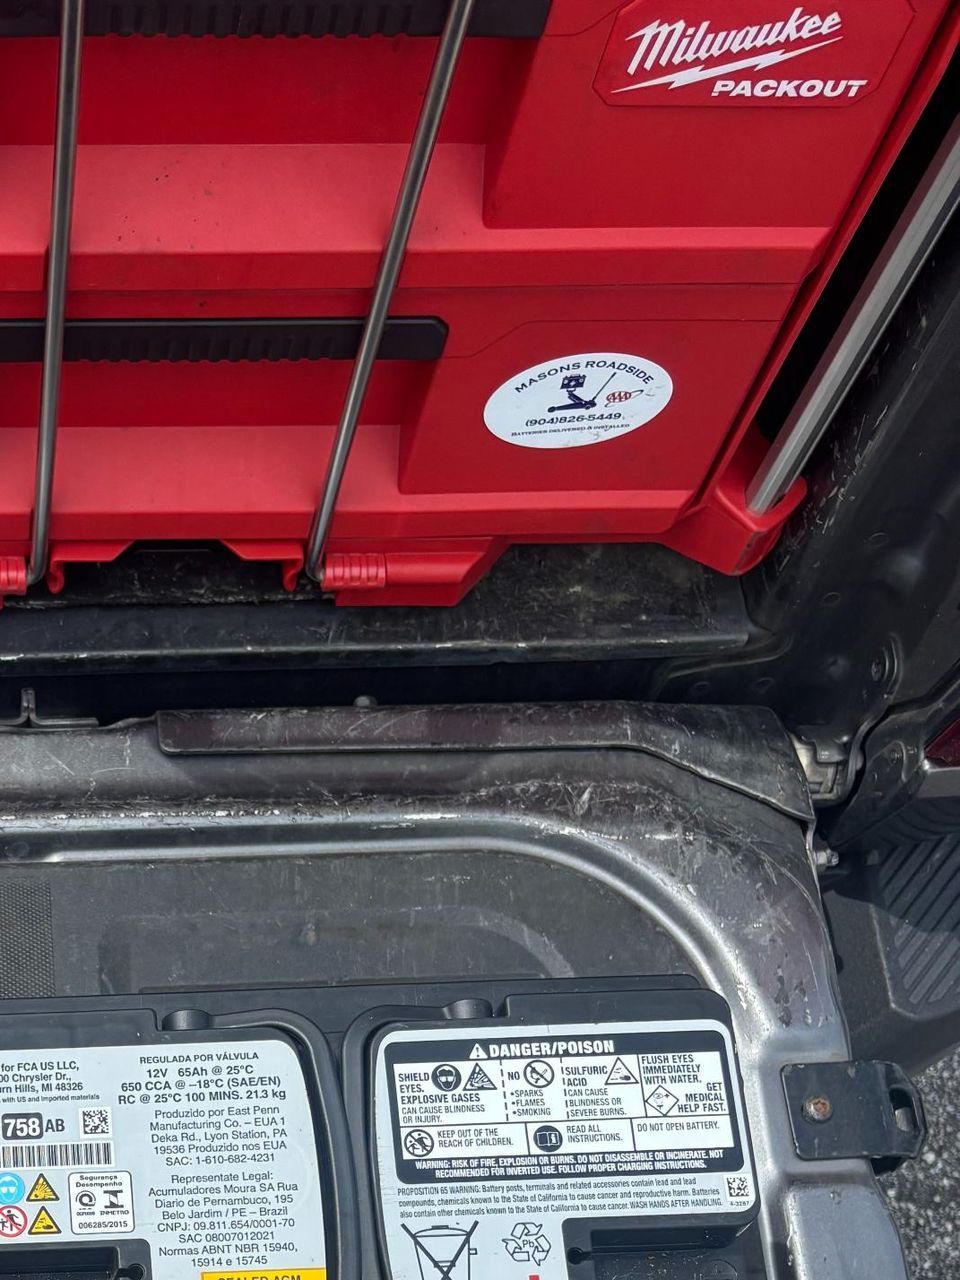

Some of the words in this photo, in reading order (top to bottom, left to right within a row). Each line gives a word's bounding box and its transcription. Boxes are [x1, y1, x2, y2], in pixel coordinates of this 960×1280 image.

[625, 7, 842, 75] Milwaukee
[711, 80, 868, 97] PACKOUT
[514, 362, 580, 393] MASONS
[585, 360, 654, 384] ROADSIDE
[608, 391, 631, 402] AAA
[525, 413, 621, 427] (904)826-5449
[489, 1040, 615, 1057] DANGER/POISON
[139, 1054, 192, 1064] REGULADA
[193, 1053, 214, 1062] POR
[215, 1052, 259, 1061] VÁLVULA
[639, 1055, 669, 1065] FLUSH
[671, 1054, 694, 1063] EYES
[0, 1063, 15, 1072] for
[17, 1062, 38, 1071] FCA
[40, 1061, 54, 1071] US
[56, 1060, 79, 1071] LLC,
[146, 1067, 168, 1078] 12V
[177, 1066, 208, 1077] 65Ah
[211, 1065, 223, 1075] @
[226, 1064, 254, 1075] 25°C
[565, 1066, 608, 1076] SULFURIC
[642, 1065, 701, 1074] IMMEDIATELY
[11, 1072, 53, 1083] Chrysler
[55, 1071, 71, 1081] Dr.,
[398, 1072, 430, 1082] SHIELD
[567, 1078, 587, 1086] ACID
[120, 1081, 142, 1092] 650
[144, 1080, 172, 1091] CCA
[174, 1079, 185, 1090] @
[227, 1075, 281, 1090] (SAE/EN)
[399, 1084, 425, 1093] EYES.
[400, 1093, 449, 1104] EXPLOSIVE
[451, 1093, 480, 1103] GASES
[154, 1108, 205, 1119] Produzido
[207, 1109, 225, 1119] por
[227, 1106, 250, 1116] East
[252, 1105, 280, 1115] Penn
[4, 1115, 41, 1137] 758
[45, 1119, 65, 1132] AB
[636, 1122, 648, 1132] DO
[649, 1122, 664, 1131] NOT
[665, 1122, 684, 1131] OPEN
[685, 1120, 719, 1130] BATTERY.
[165, 1156, 192, 1167] SAC:
[195, 1152, 274, 1165] 1-610-682-4231
[79, 1221, 128, 1229] 006285/2015
[157, 1221, 190, 1232] CNPJ:
[193, 1217, 295, 1231] 09.811.654/0001-70
